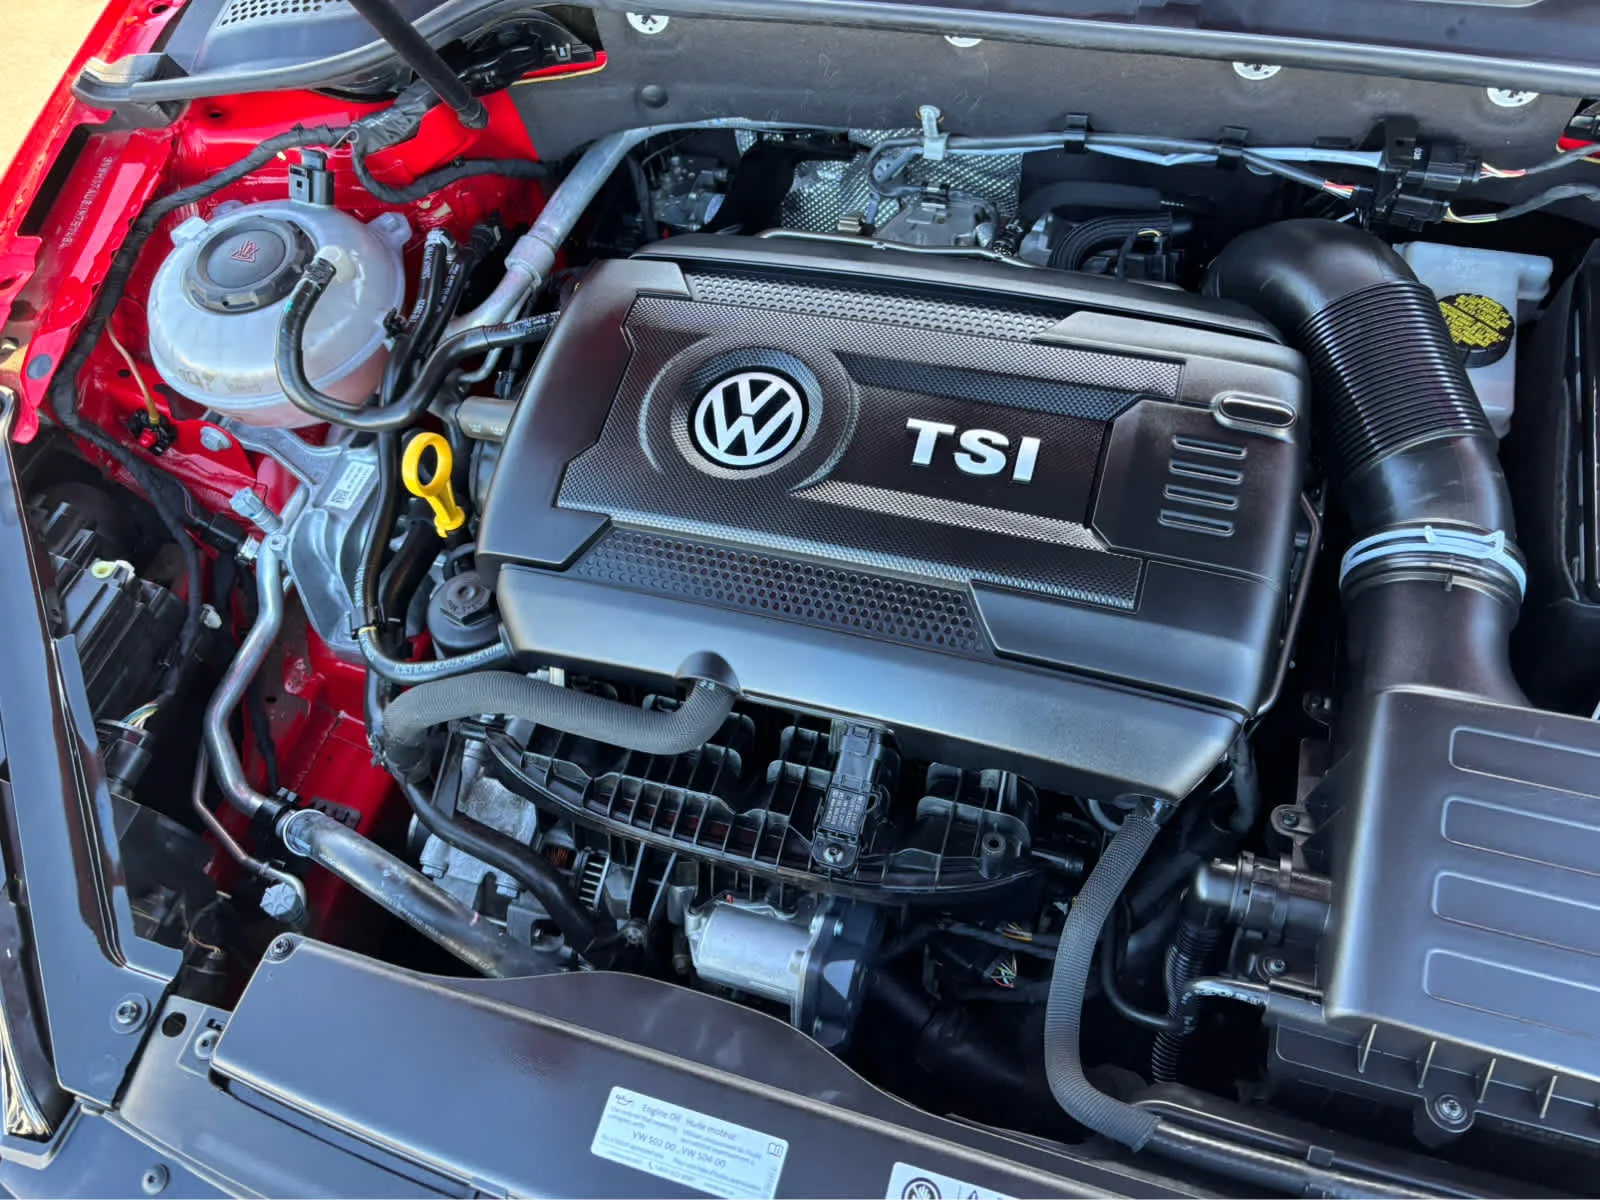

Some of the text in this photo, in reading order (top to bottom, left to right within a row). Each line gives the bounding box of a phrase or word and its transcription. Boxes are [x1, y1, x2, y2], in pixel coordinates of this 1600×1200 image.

[695, 372, 802, 466] VW
[906, 418, 1040, 483] TSI
[632, 1129, 647, 1143] VW
